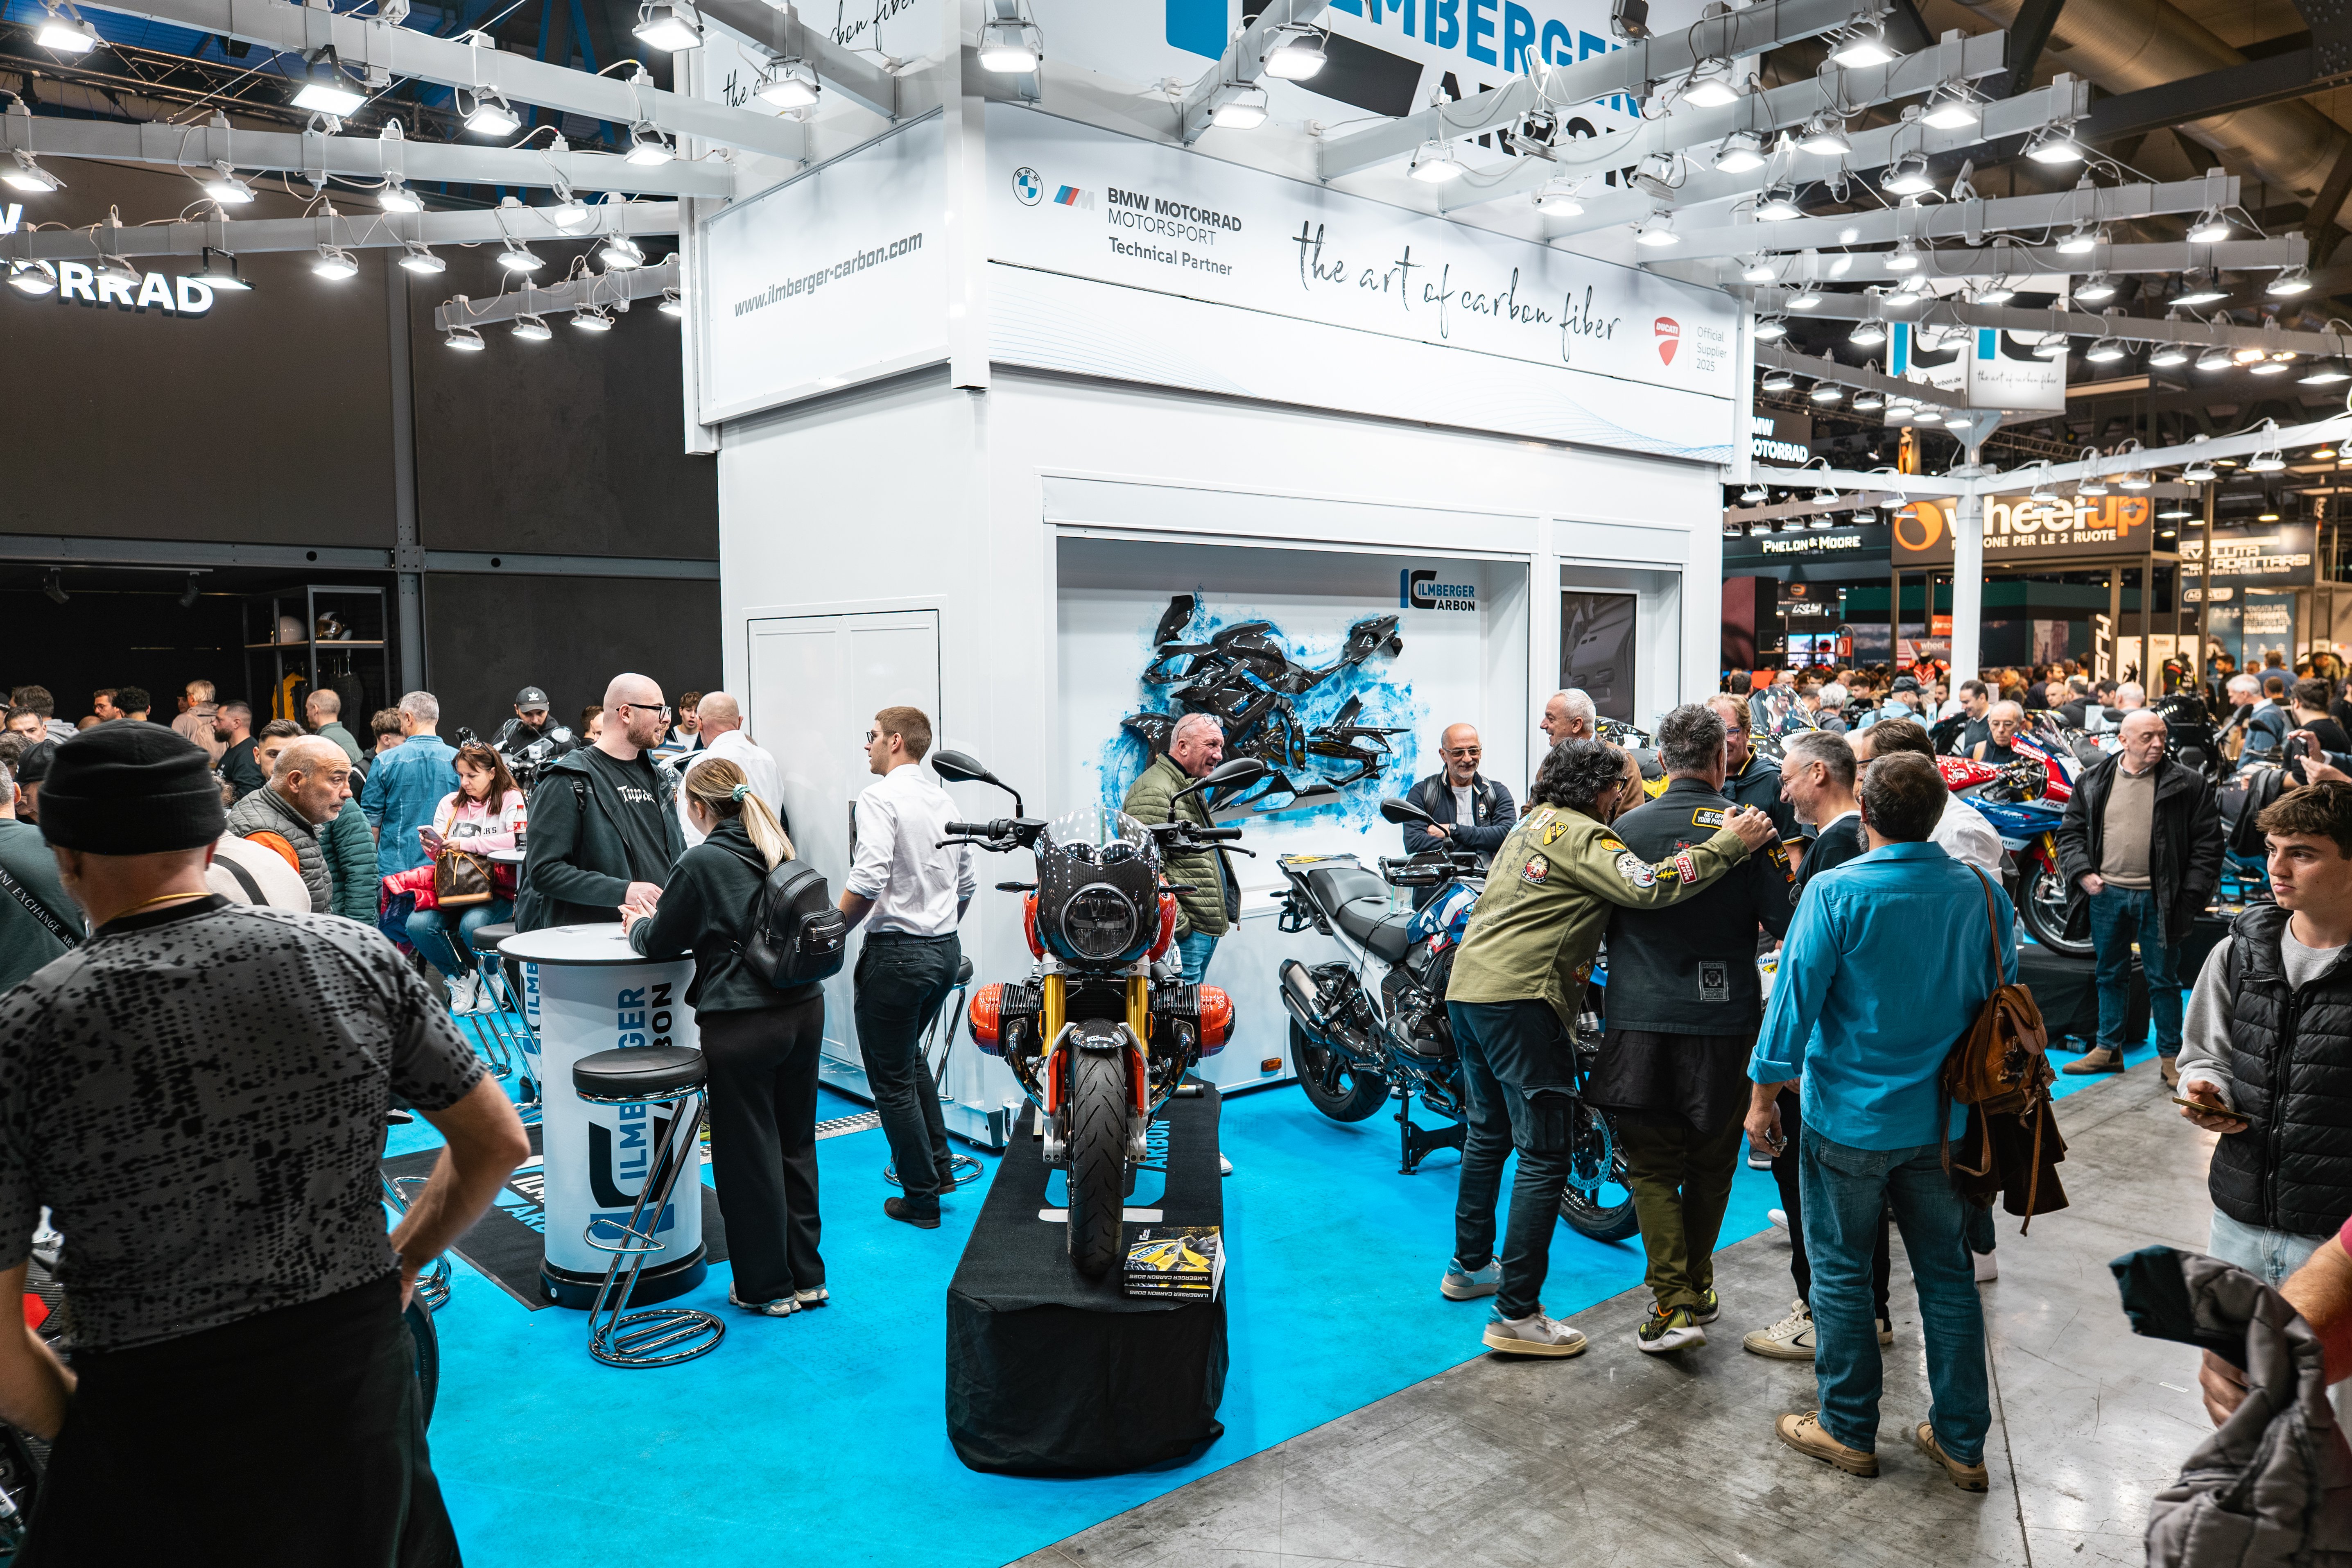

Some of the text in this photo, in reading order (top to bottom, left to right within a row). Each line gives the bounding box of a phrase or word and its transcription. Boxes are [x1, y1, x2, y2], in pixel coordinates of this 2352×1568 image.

[1108, 187, 1242, 233] BMW MOTORRAD
[1108, 208, 1216, 246] MOTORSPORT
[1109, 235, 1233, 276] Technical Partner
[735, 230, 922, 317] www.ilmberger-carbon.com
[1293, 220, 1621, 362] the art of carbon fiber
[1656, 322, 1678, 334] DUCATI
[1697, 326, 1724, 342] Official
[1697, 342, 1727, 358] Supplier
[1697, 358, 1715, 371] 2025
[1934, 376, 1962, 388] arbon.de
[1751, 416, 1774, 437] MW
[1751, 438, 1808, 464] OTORRAD
[2013, 534, 2036, 547] PER
[2041, 534, 2056, 544] LE
[2060, 532, 2068, 544] 2
[2074, 529, 2116, 542] RUOTE
[2214, 554, 2310, 569] ADATTARSI
[1418, 584, 1475, 598] ILMBERGER
[12, 887, 61, 932] EXCHANGE
[1132, 1245, 1163, 1258] 2026
